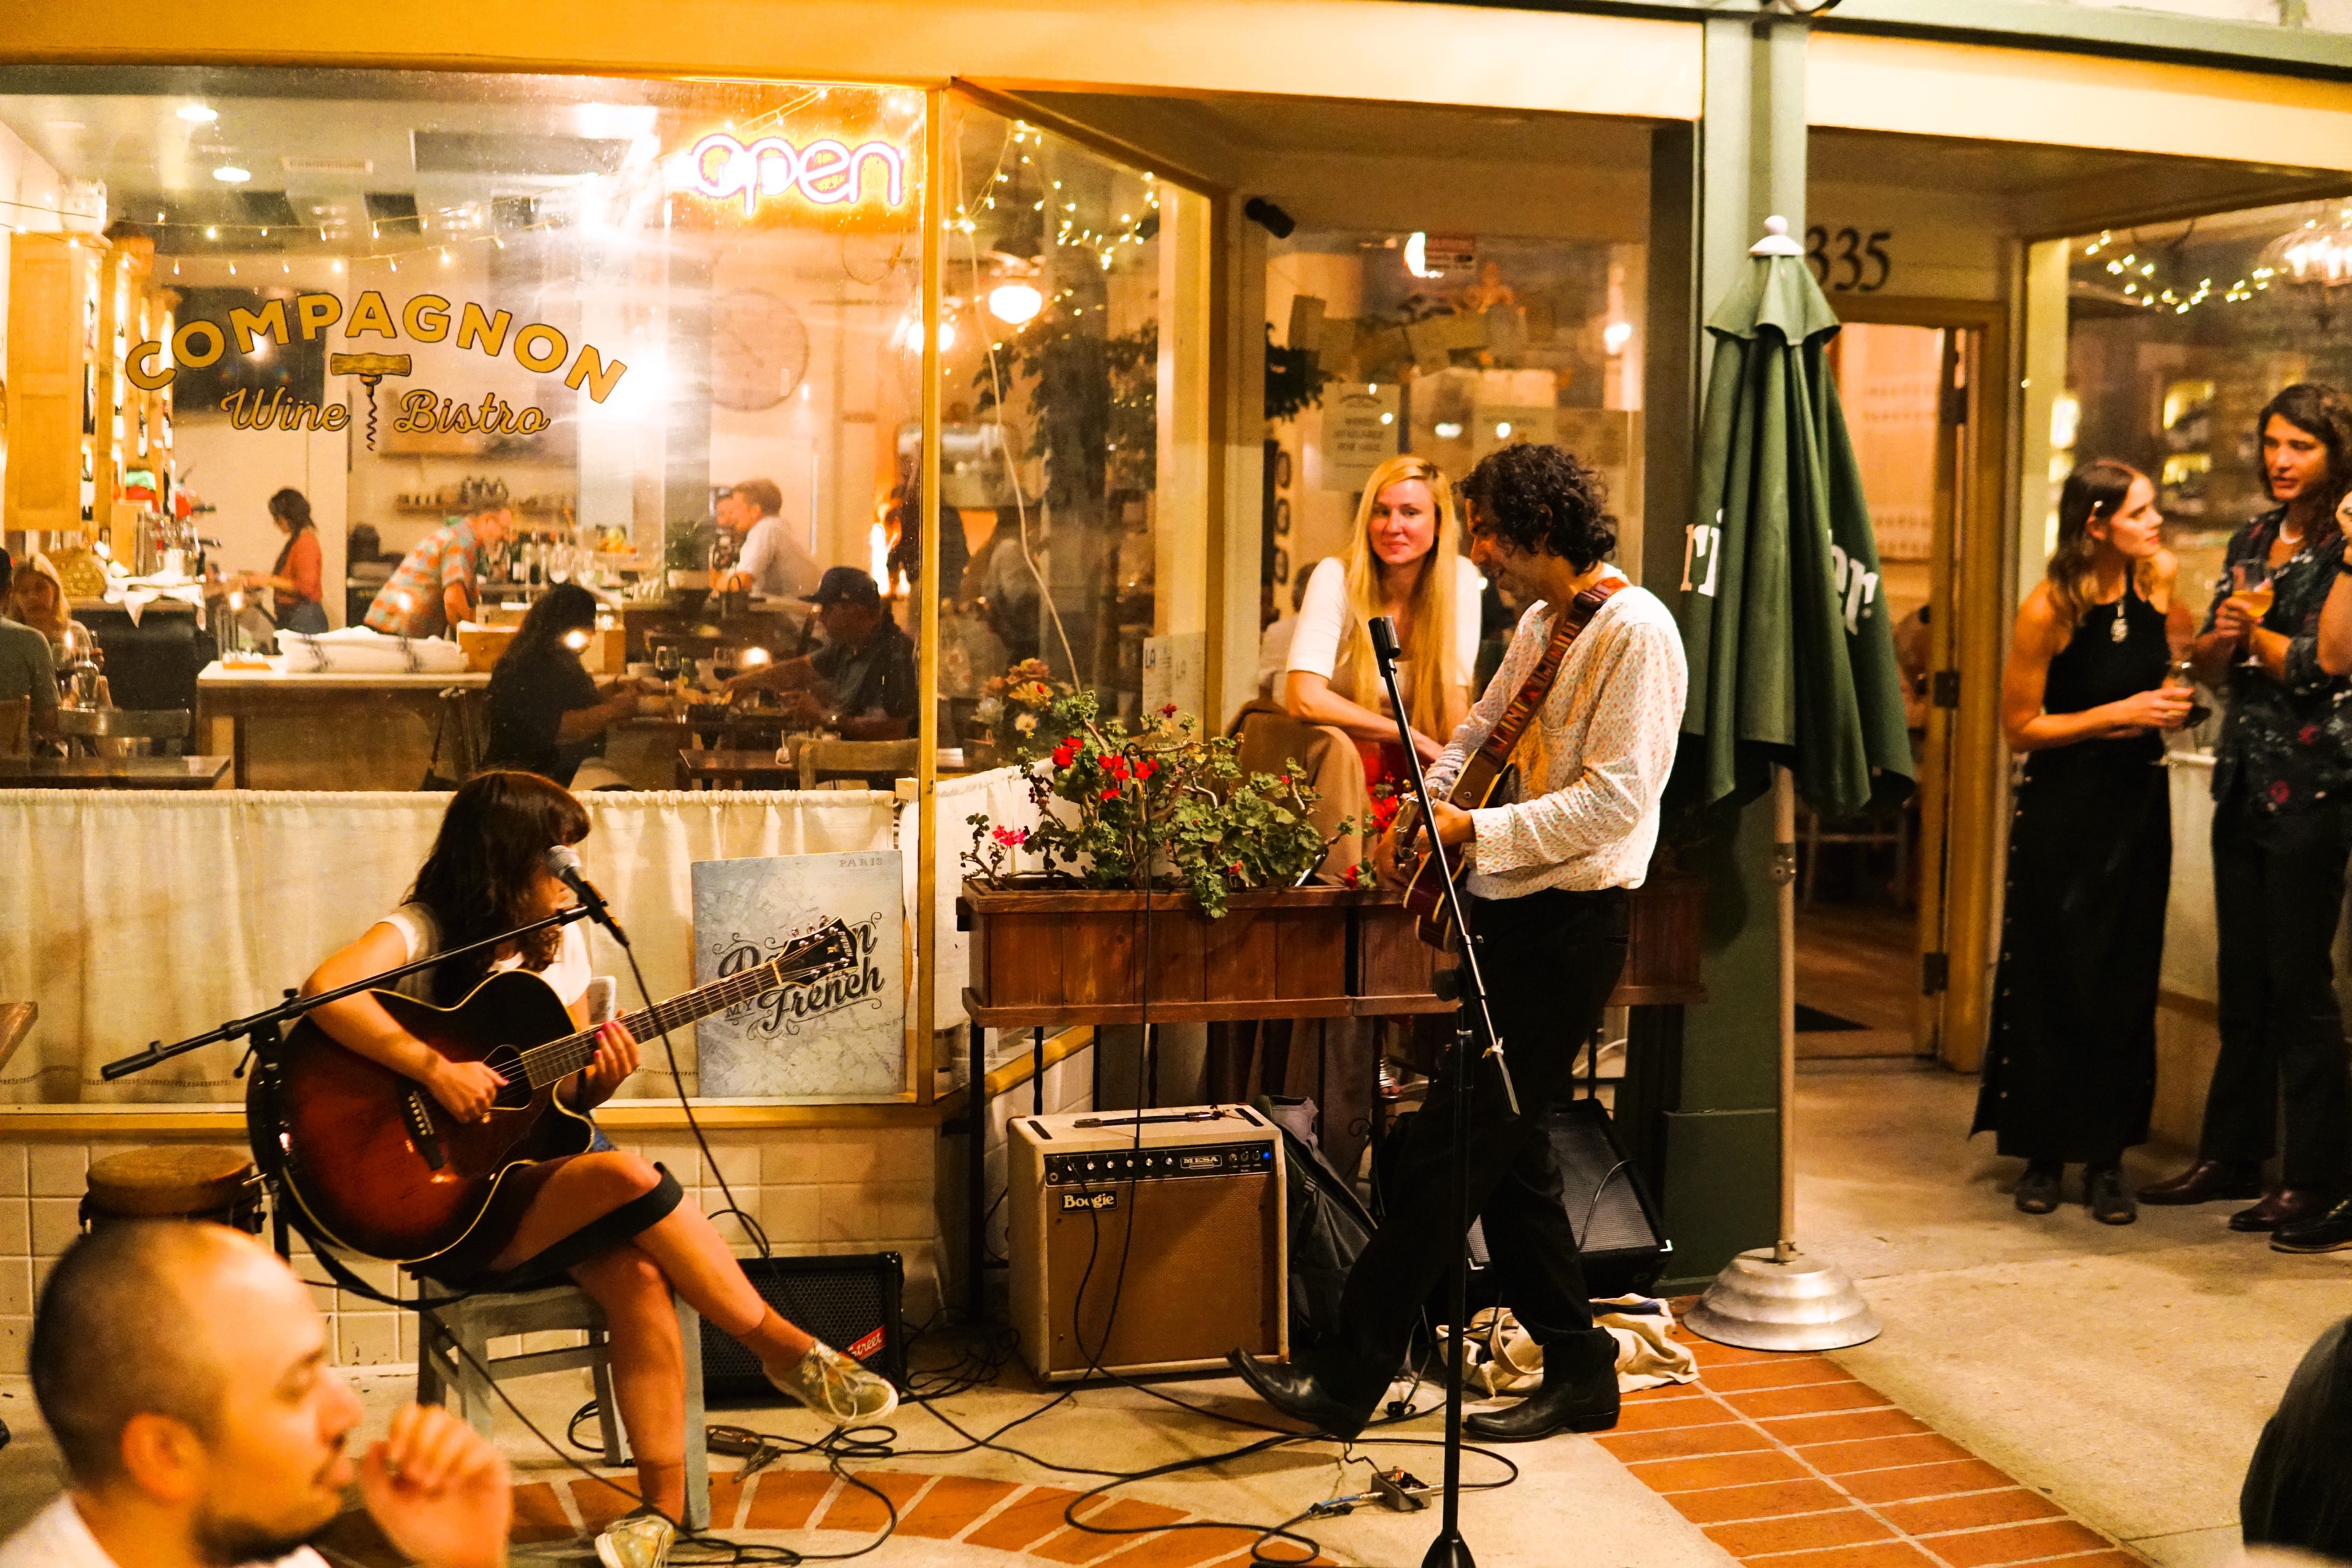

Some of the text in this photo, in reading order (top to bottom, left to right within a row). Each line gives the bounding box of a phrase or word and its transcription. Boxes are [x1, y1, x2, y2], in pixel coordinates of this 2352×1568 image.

[125, 291, 627, 404] COMPAGNON
[220, 386, 551, 434] Wine Bistro
[839, 858, 883, 868] PARIS
[757, 956, 886, 1031] French
